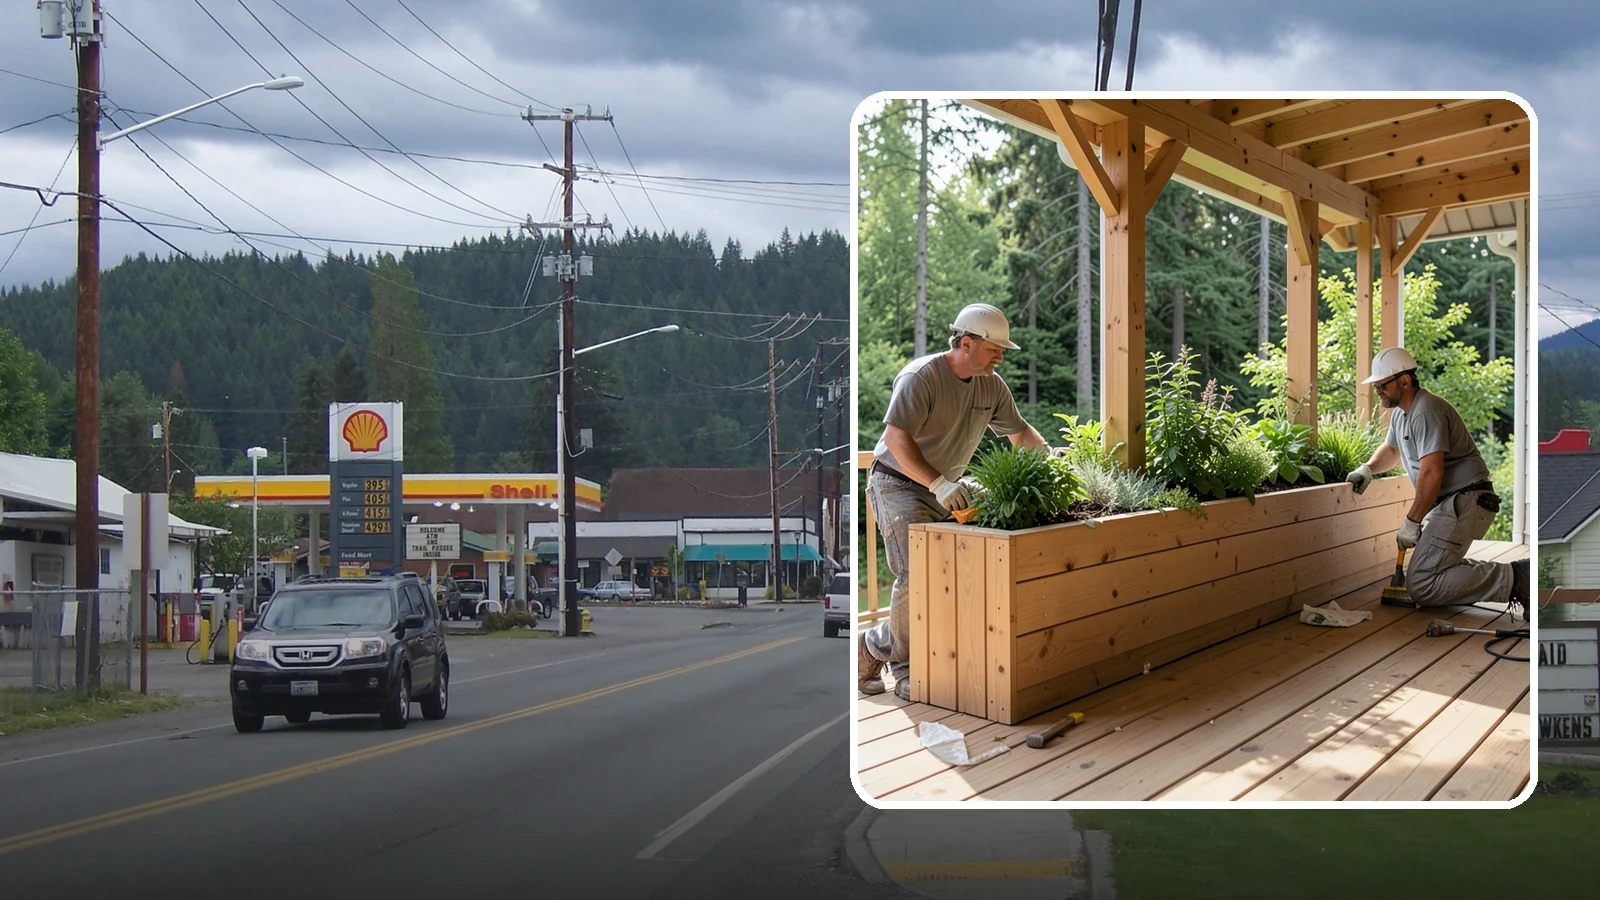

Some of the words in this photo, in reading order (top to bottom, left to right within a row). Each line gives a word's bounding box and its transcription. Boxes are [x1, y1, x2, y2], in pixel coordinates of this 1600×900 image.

[366, 480, 384, 490] 395
[490, 484, 547, 499] Shell
[366, 494, 384, 504] 405
[366, 508, 384, 518] 415
[366, 522, 384, 532] 429
